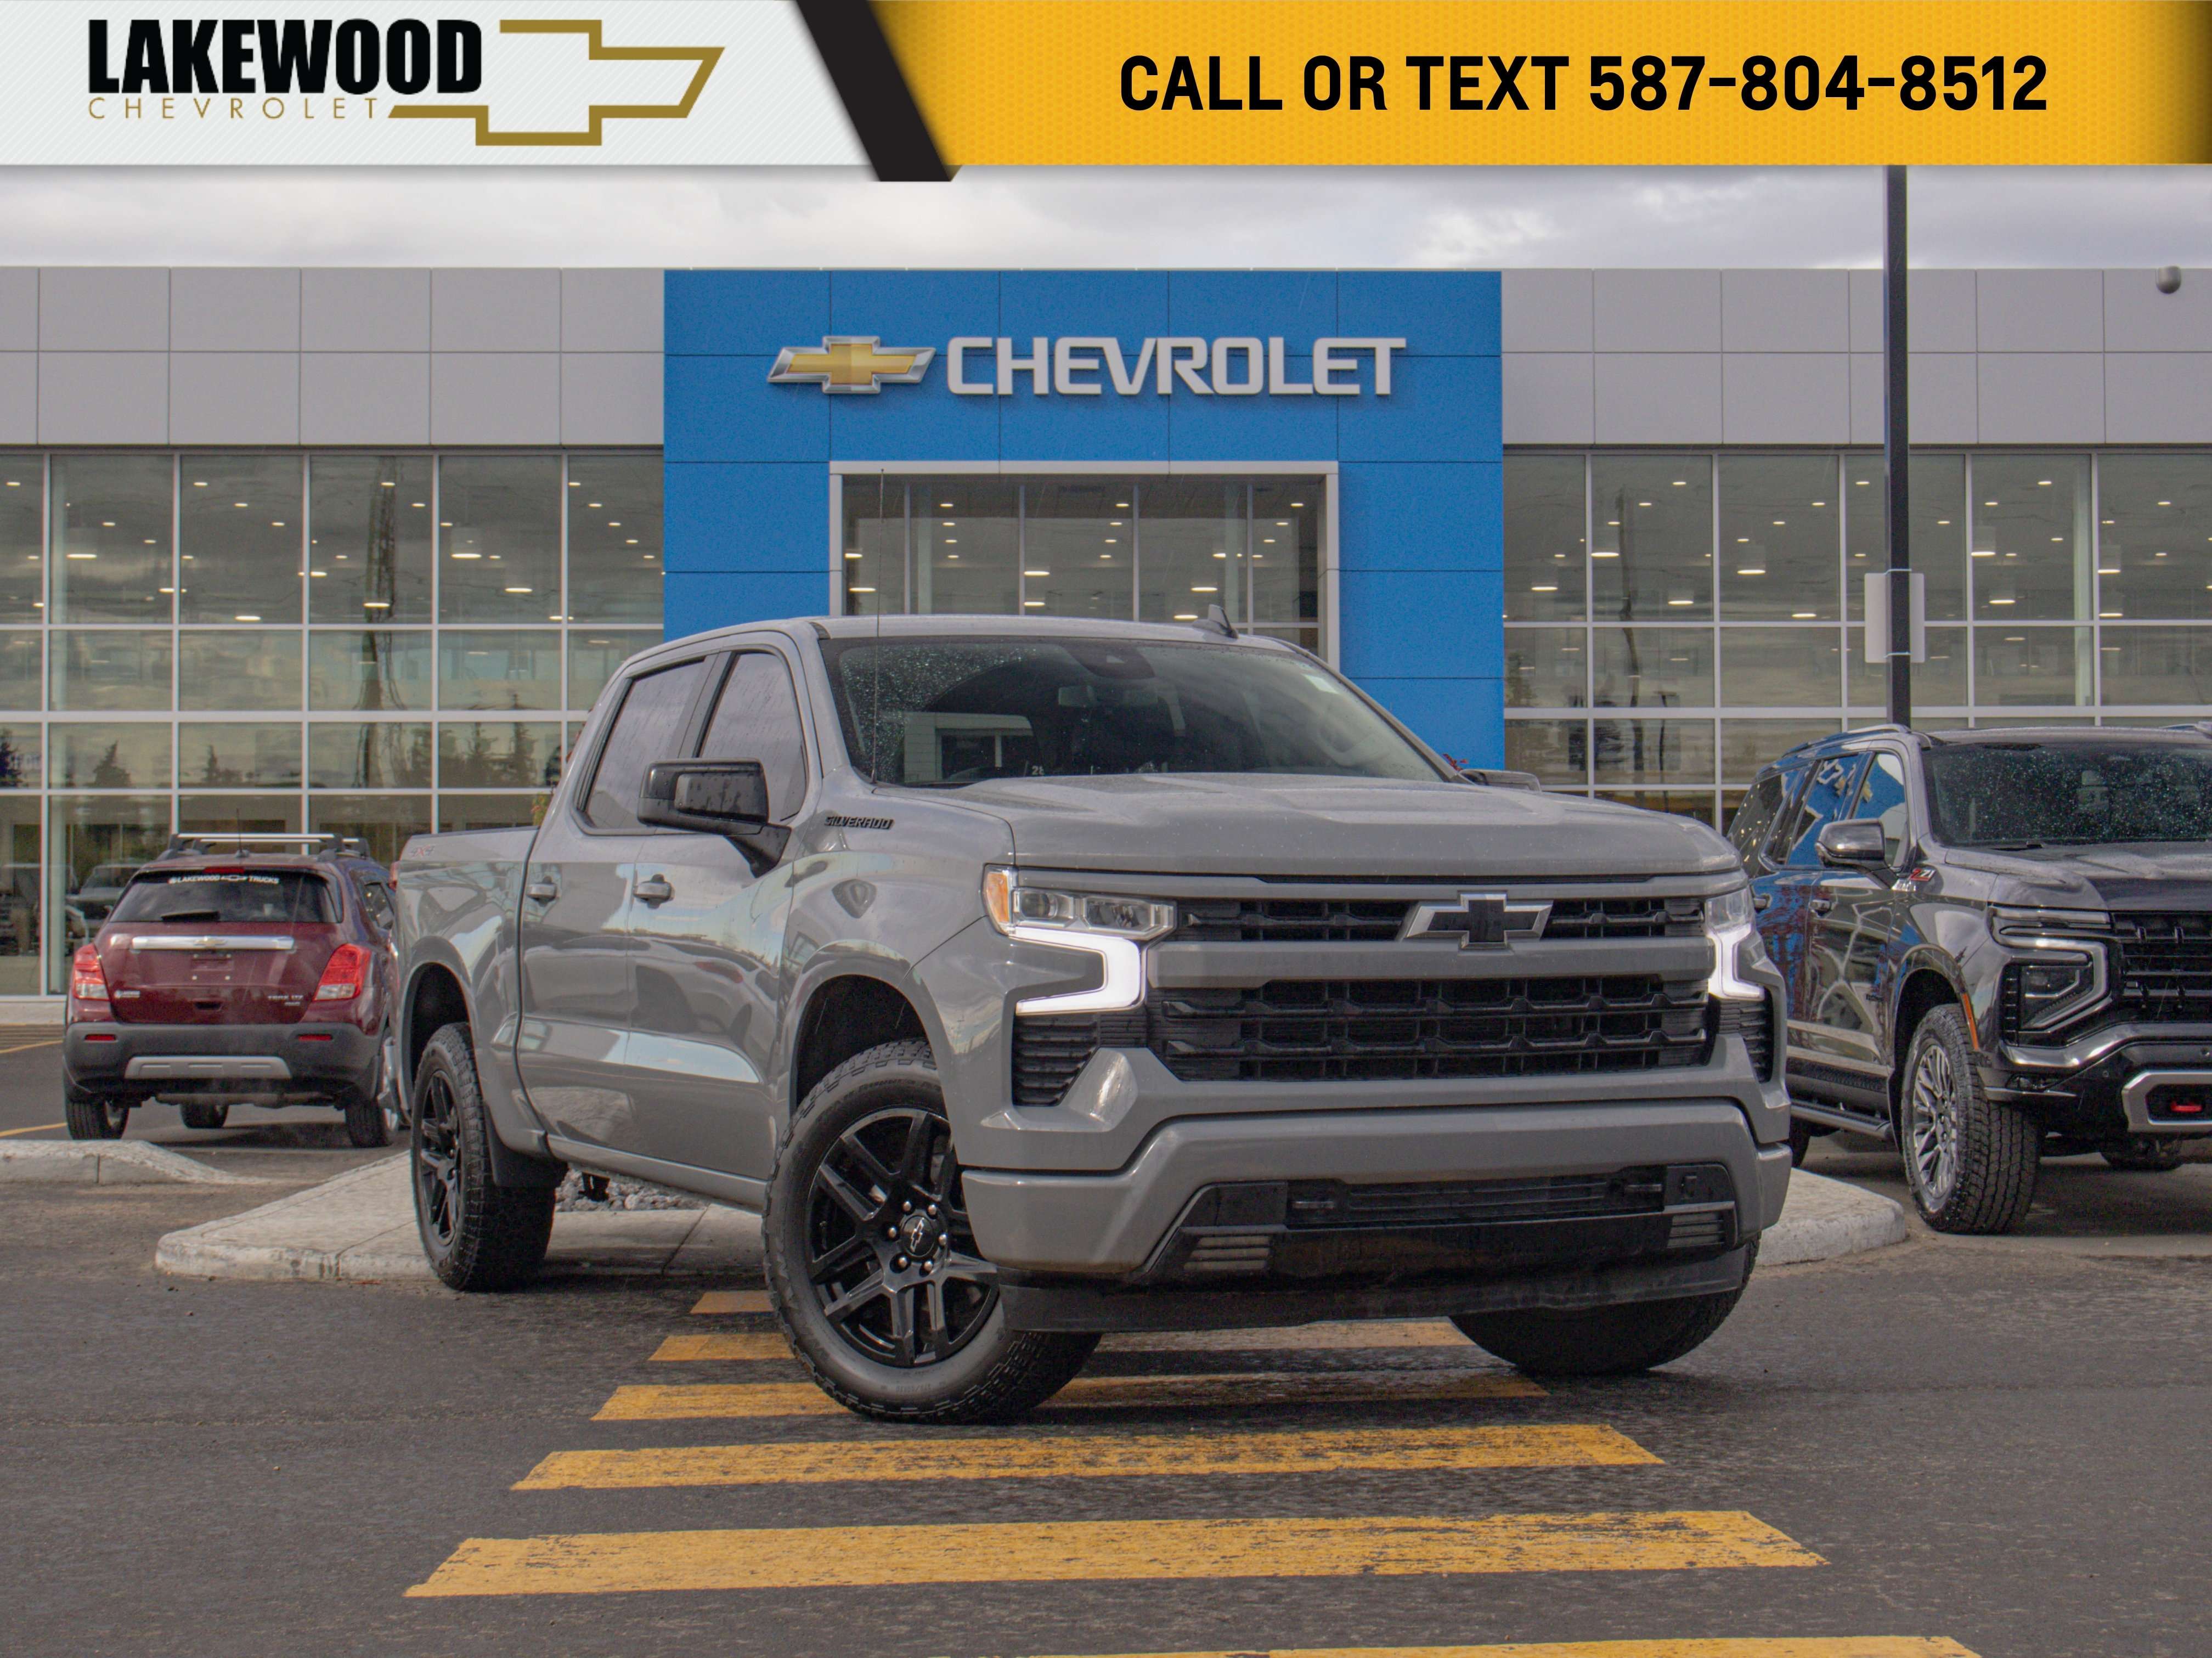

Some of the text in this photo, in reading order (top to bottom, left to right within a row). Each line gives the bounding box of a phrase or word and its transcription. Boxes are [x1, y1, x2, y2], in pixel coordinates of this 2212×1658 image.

[946, 336, 1407, 395] CHEVROLET
[825, 816, 894, 829] SILVERADO
[178, 875, 280, 884] LAKEWOOD TRUCKS
